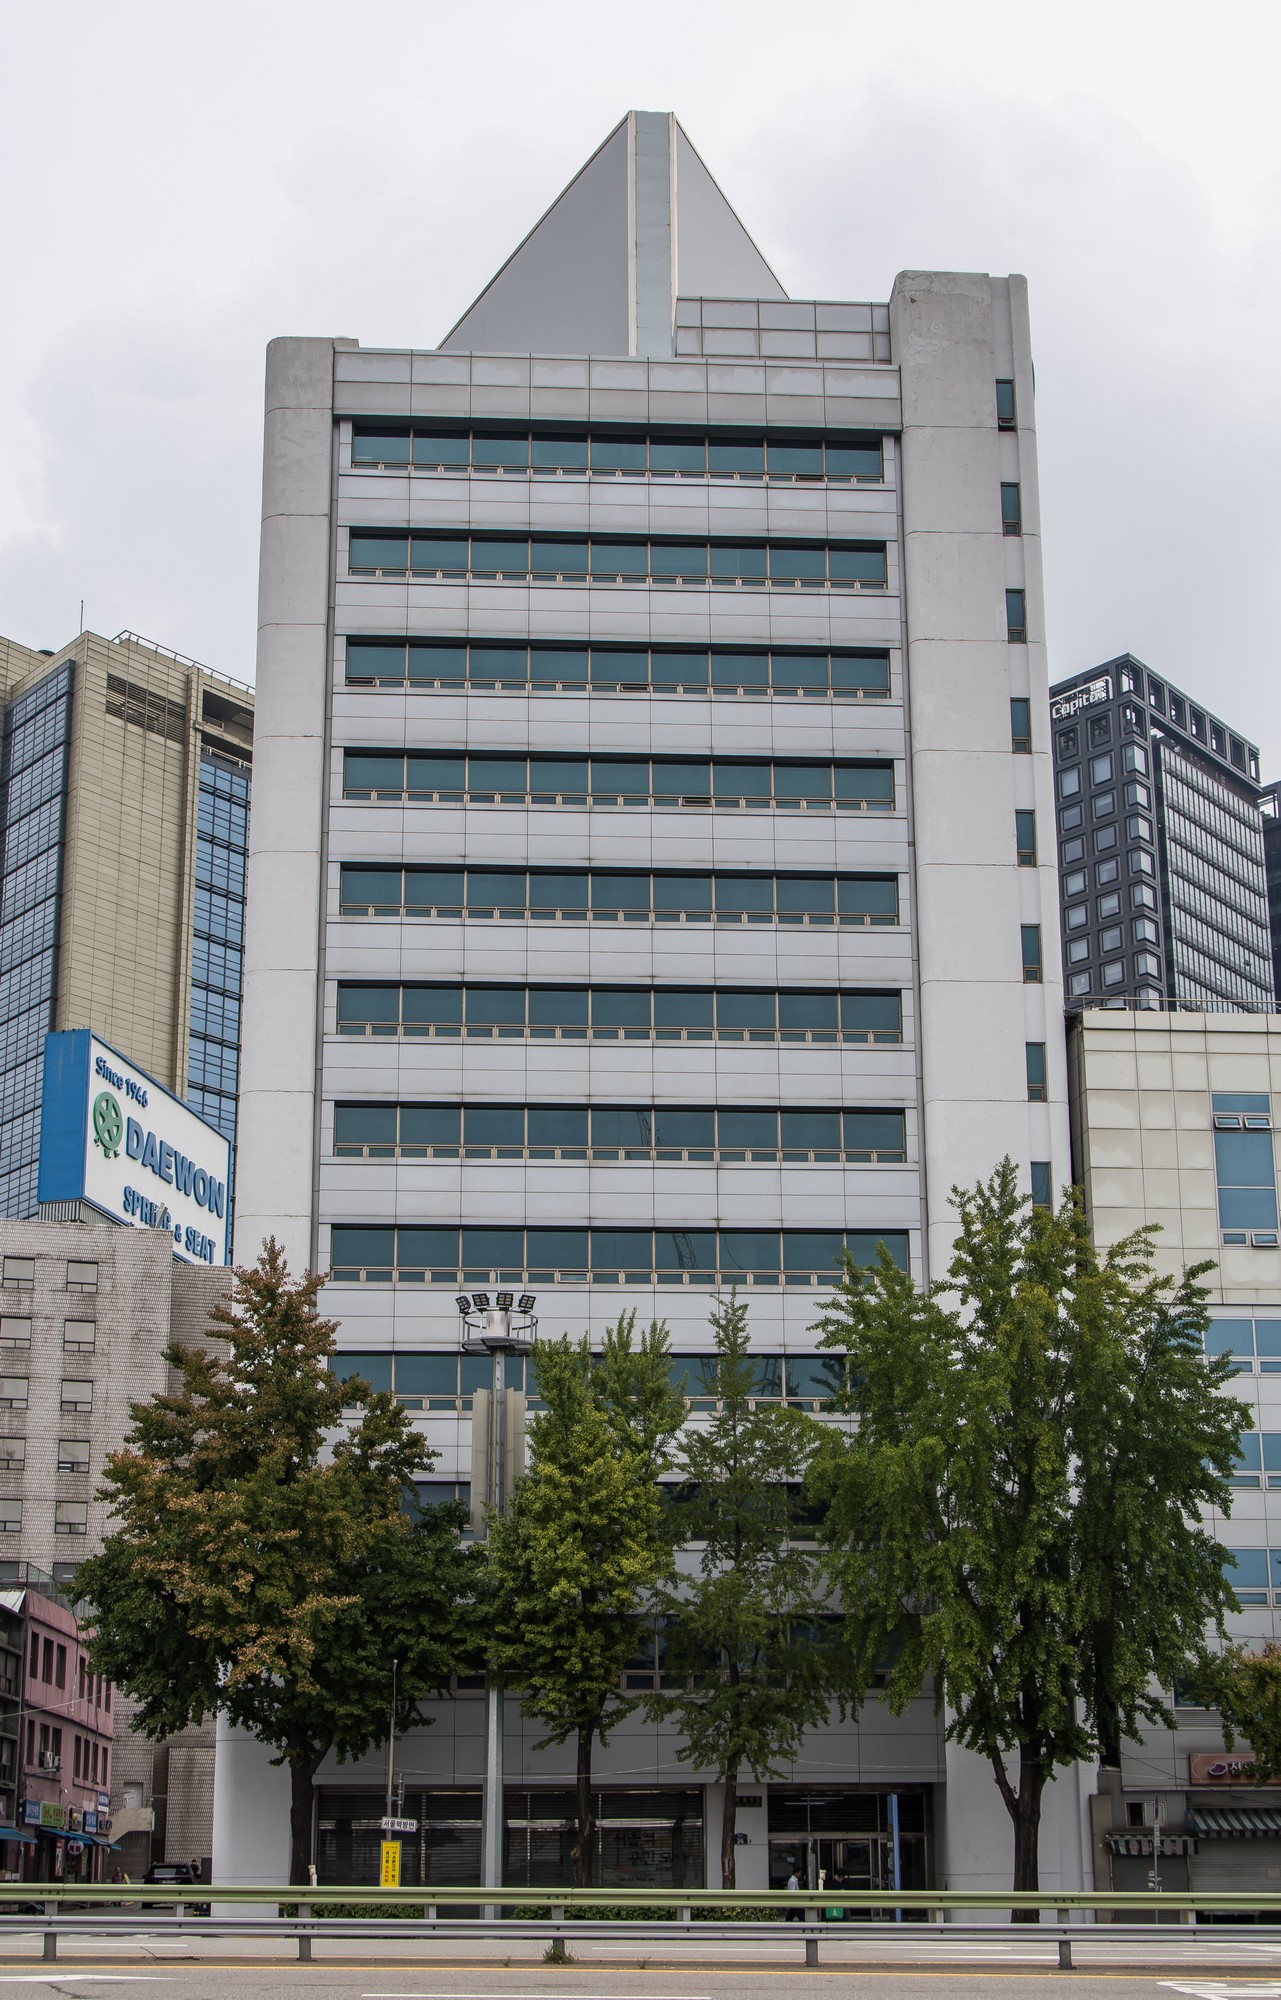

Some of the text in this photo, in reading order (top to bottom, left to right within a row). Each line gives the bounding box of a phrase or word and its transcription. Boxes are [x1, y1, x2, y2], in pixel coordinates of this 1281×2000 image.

[95, 1056, 148, 1108] Since 1946
[126, 1116, 225, 1219] DAEWON
[123, 1185, 217, 1265] SPRIG & SEAT
[383, 1819, 415, 1830] 서울역방면
[615, 1832, 655, 1848] 서울역
